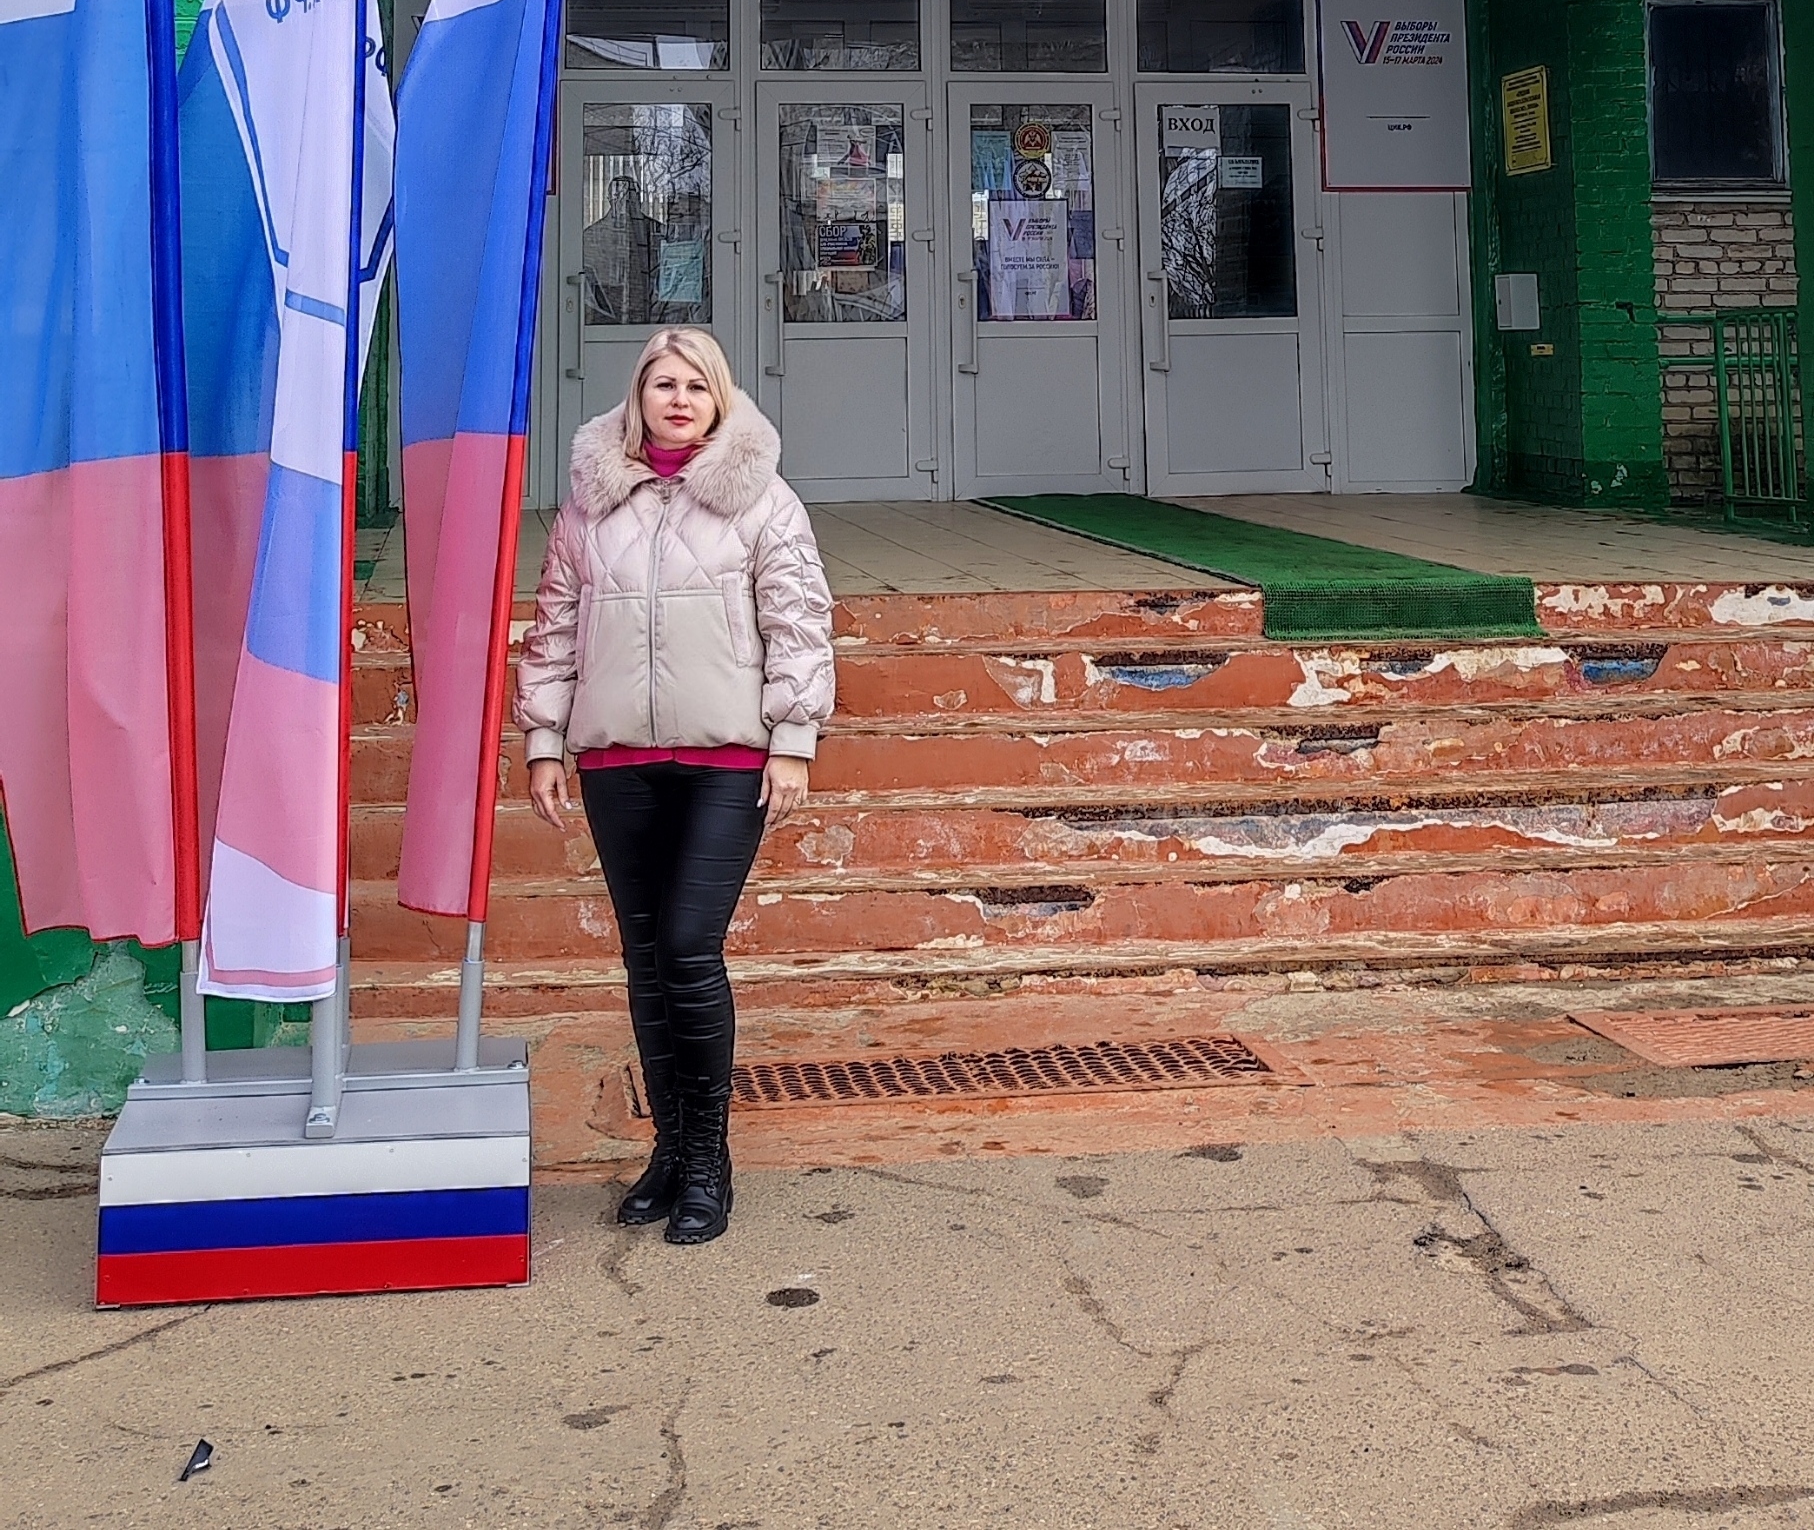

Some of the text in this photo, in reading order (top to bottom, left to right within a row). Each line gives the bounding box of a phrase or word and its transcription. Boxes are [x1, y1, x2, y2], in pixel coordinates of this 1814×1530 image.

[1394, 21, 1438, 31] ВЫБОРЫ
[1390, 33, 1451, 44] ПРЕЗИДЕНТА
[1386, 45, 1425, 55] РОССИИ
[1401, 56, 1426, 65] МАРТА
[1426, 56, 1443, 65] 2024
[1168, 117, 1216, 135] ВХОД
[1387, 124, 1412, 132] ЦИК.РФ
[818, 225, 848, 238] СБОР
